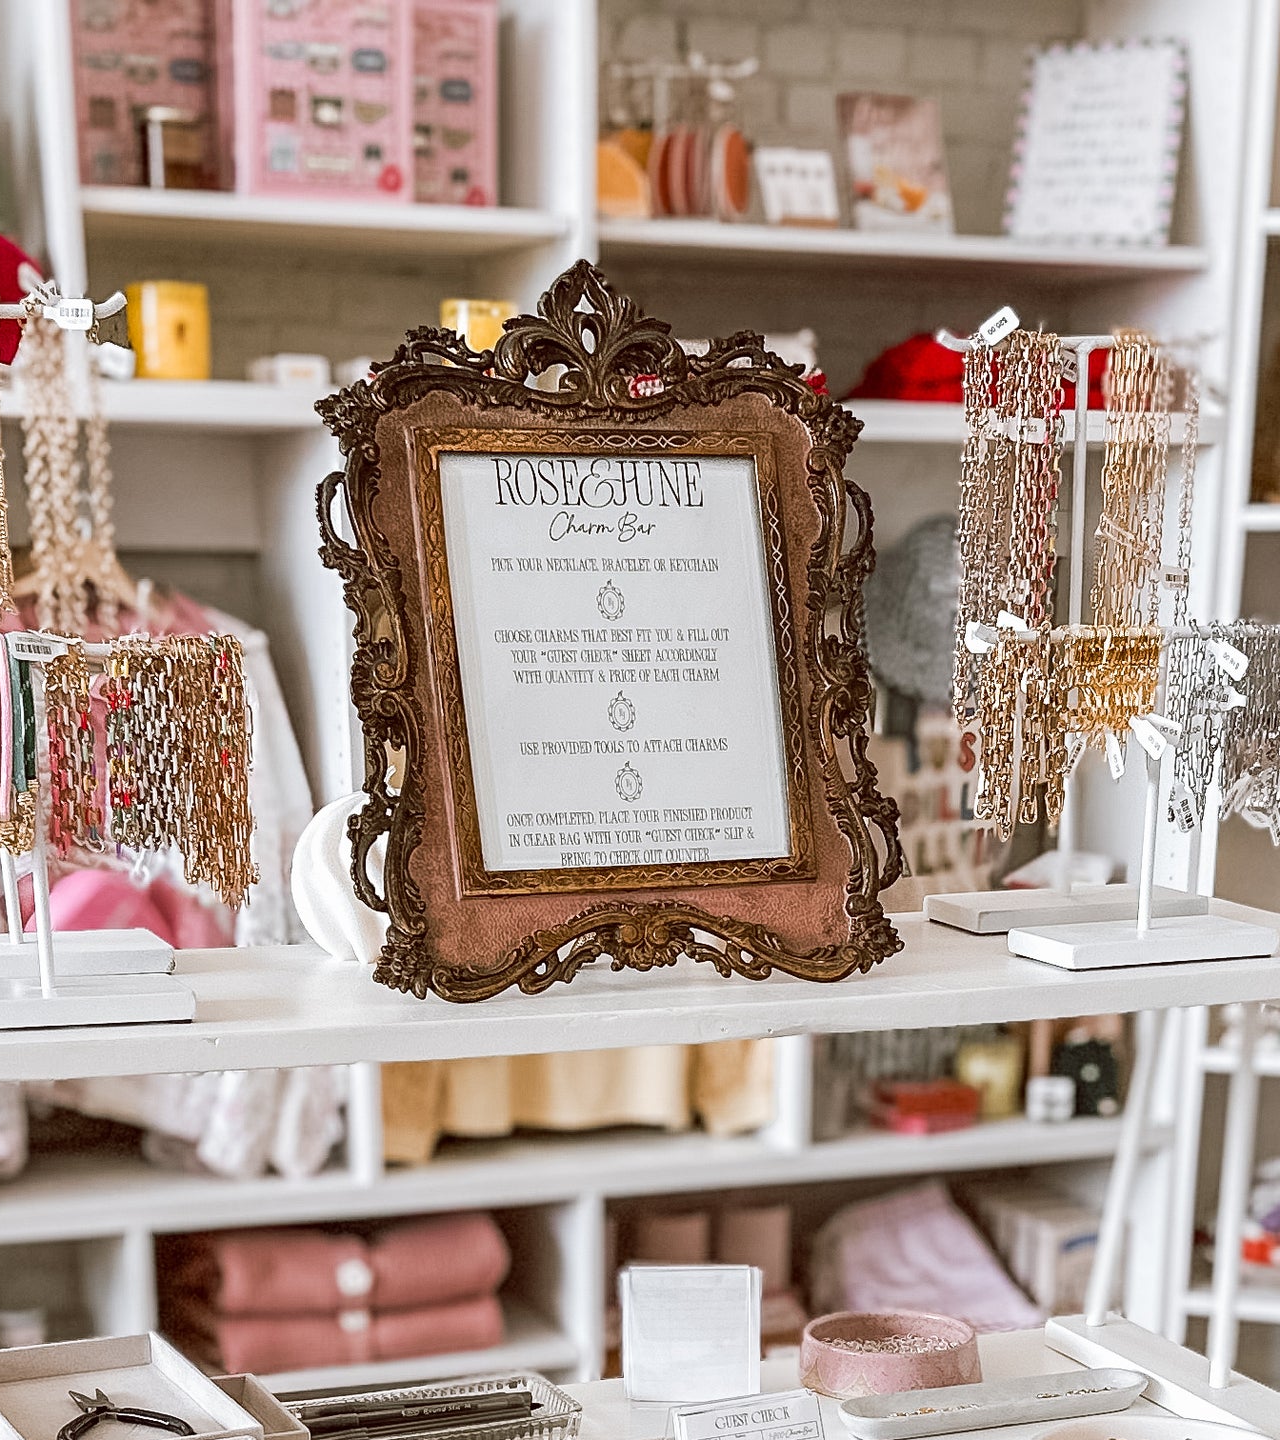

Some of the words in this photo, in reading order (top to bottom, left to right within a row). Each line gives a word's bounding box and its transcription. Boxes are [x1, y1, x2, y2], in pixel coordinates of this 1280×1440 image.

[492, 458, 703, 508] ROSE&JUNE
[549, 511, 614, 541] Charm
[618, 511, 656, 542] Bar
[491, 558, 513, 572] PICK
[516, 558, 542, 572] YOUR
[654, 558, 667, 572] OR
[669, 558, 719, 572] KEYCHAIN
[494, 630, 532, 644] CHOOSE
[535, 629, 579, 644] CHARMS
[581, 629, 607, 643] THAT
[611, 629, 632, 643] BEST
[636, 629, 652, 643] FIT
[655, 628, 672, 643] YOU
[677, 628, 684, 642] &
[688, 628, 709, 642] FILL
[711, 628, 730, 642] OUT
[511, 650, 537, 664] YOUR
[622, 649, 651, 663] SHEET
[656, 648, 718, 663] ACCORDINGLY
[513, 670, 542, 684] WITH
[545, 669, 594, 684] QUANTITY
[598, 669, 606, 683] &
[609, 669, 636, 683] PRICE
[639, 669, 650, 683] OF
[654, 668, 679, 683] EACH
[682, 668, 720, 682] CHARM
[520, 741, 539, 755] USE
[542, 740, 591, 755] PROVIDED
[594, 740, 624, 754] TOOLS
[627, 739, 639, 753] TO
[643, 738, 682, 753] ATTACH
[685, 738, 728, 752] CHARMS
[506, 812, 534, 826] ONCE
[599, 810, 630, 824] PLACE
[633, 809, 659, 823] YOUR
[663, 808, 707, 823] FINISHED
[710, 807, 753, 822] PRODUCT
[508, 833, 520, 847] IN
[523, 832, 557, 847] CLEAR
[559, 831, 581, 845] BAG
[584, 830, 612, 845] WITH
[614, 829, 642, 844] YOUR
[724, 826, 744, 840] SLIP
[746, 826, 755, 840] &
[560, 852, 591, 866] BRING
[594, 851, 607, 865] TO
[609, 850, 641, 865] CHECK
[643, 849, 663, 864] OUT
[665, 848, 710, 863] COUNTER
[715, 1412, 748, 1429] GUEST
[751, 1406, 790, 1424] CHECK
